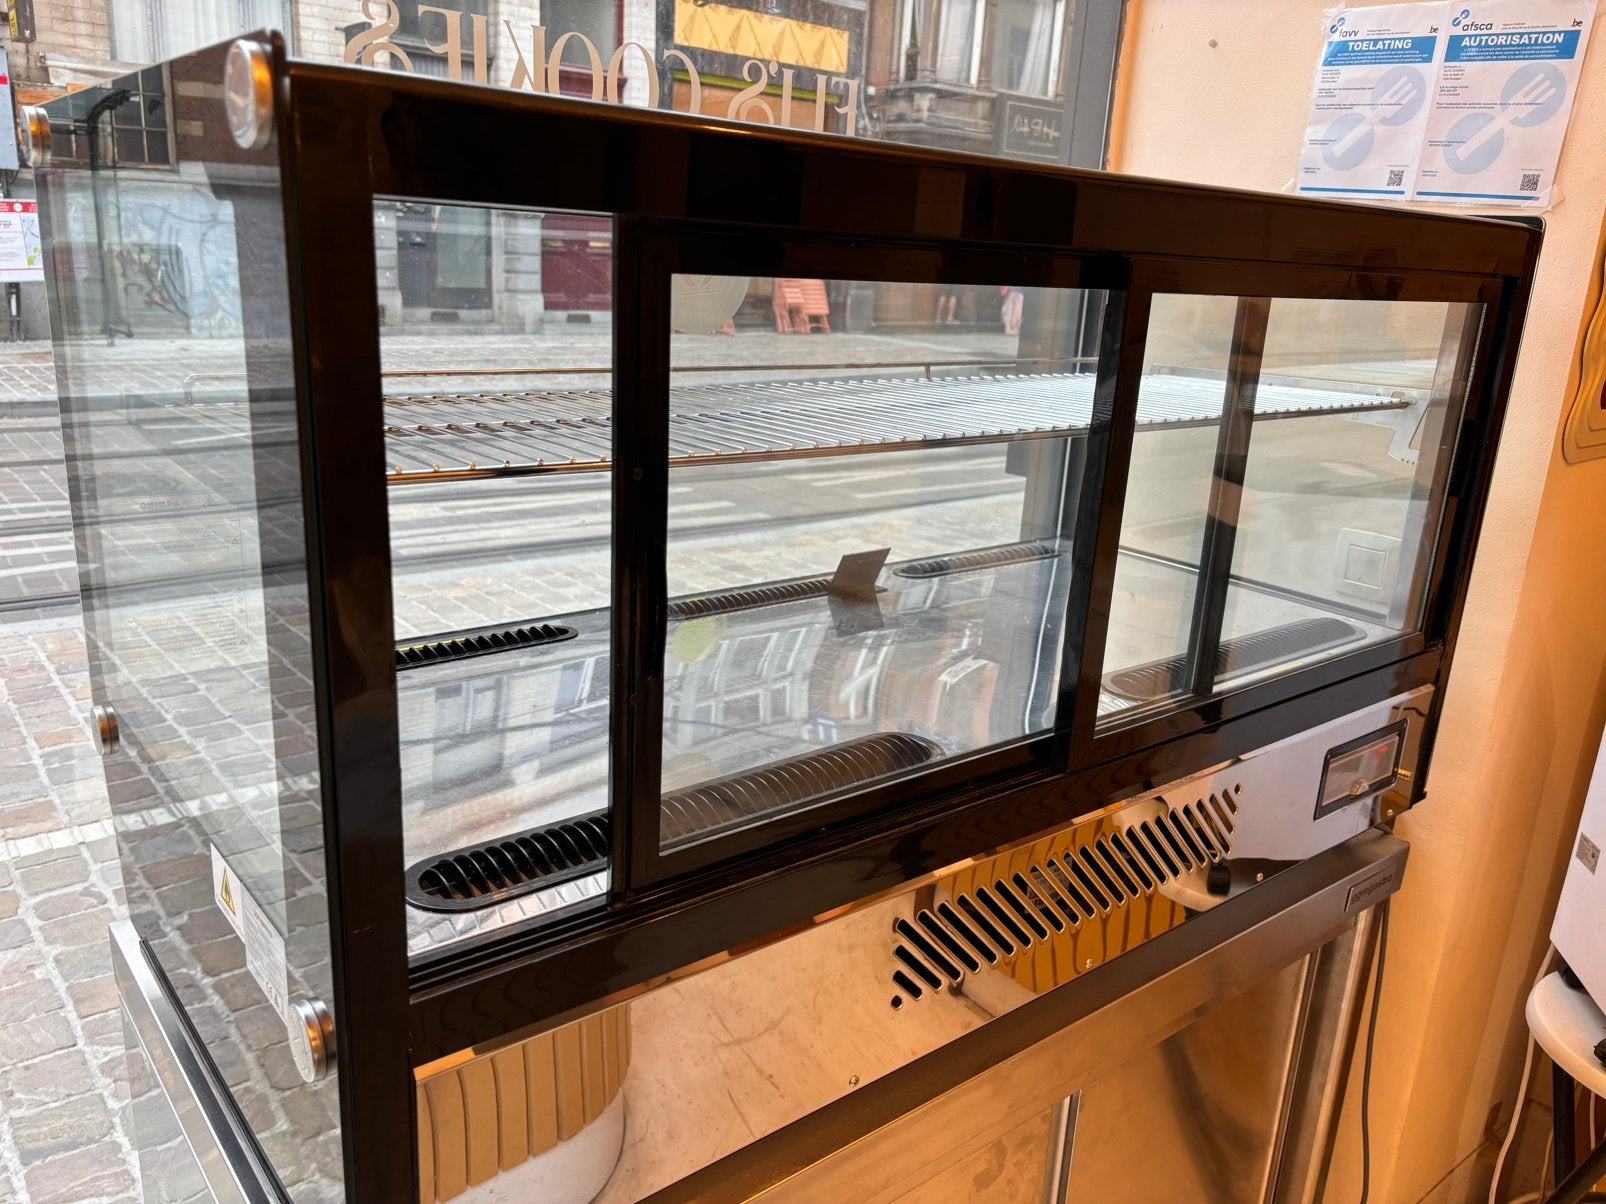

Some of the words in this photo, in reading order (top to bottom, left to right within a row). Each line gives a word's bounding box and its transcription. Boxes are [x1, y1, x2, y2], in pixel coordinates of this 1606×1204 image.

[1461, 21, 1493, 32] afsca
[1338, 28, 1360, 38] favv
[1347, 39, 1412, 51] TOELATING
[1461, 33, 1564, 47] AUTORISATION
